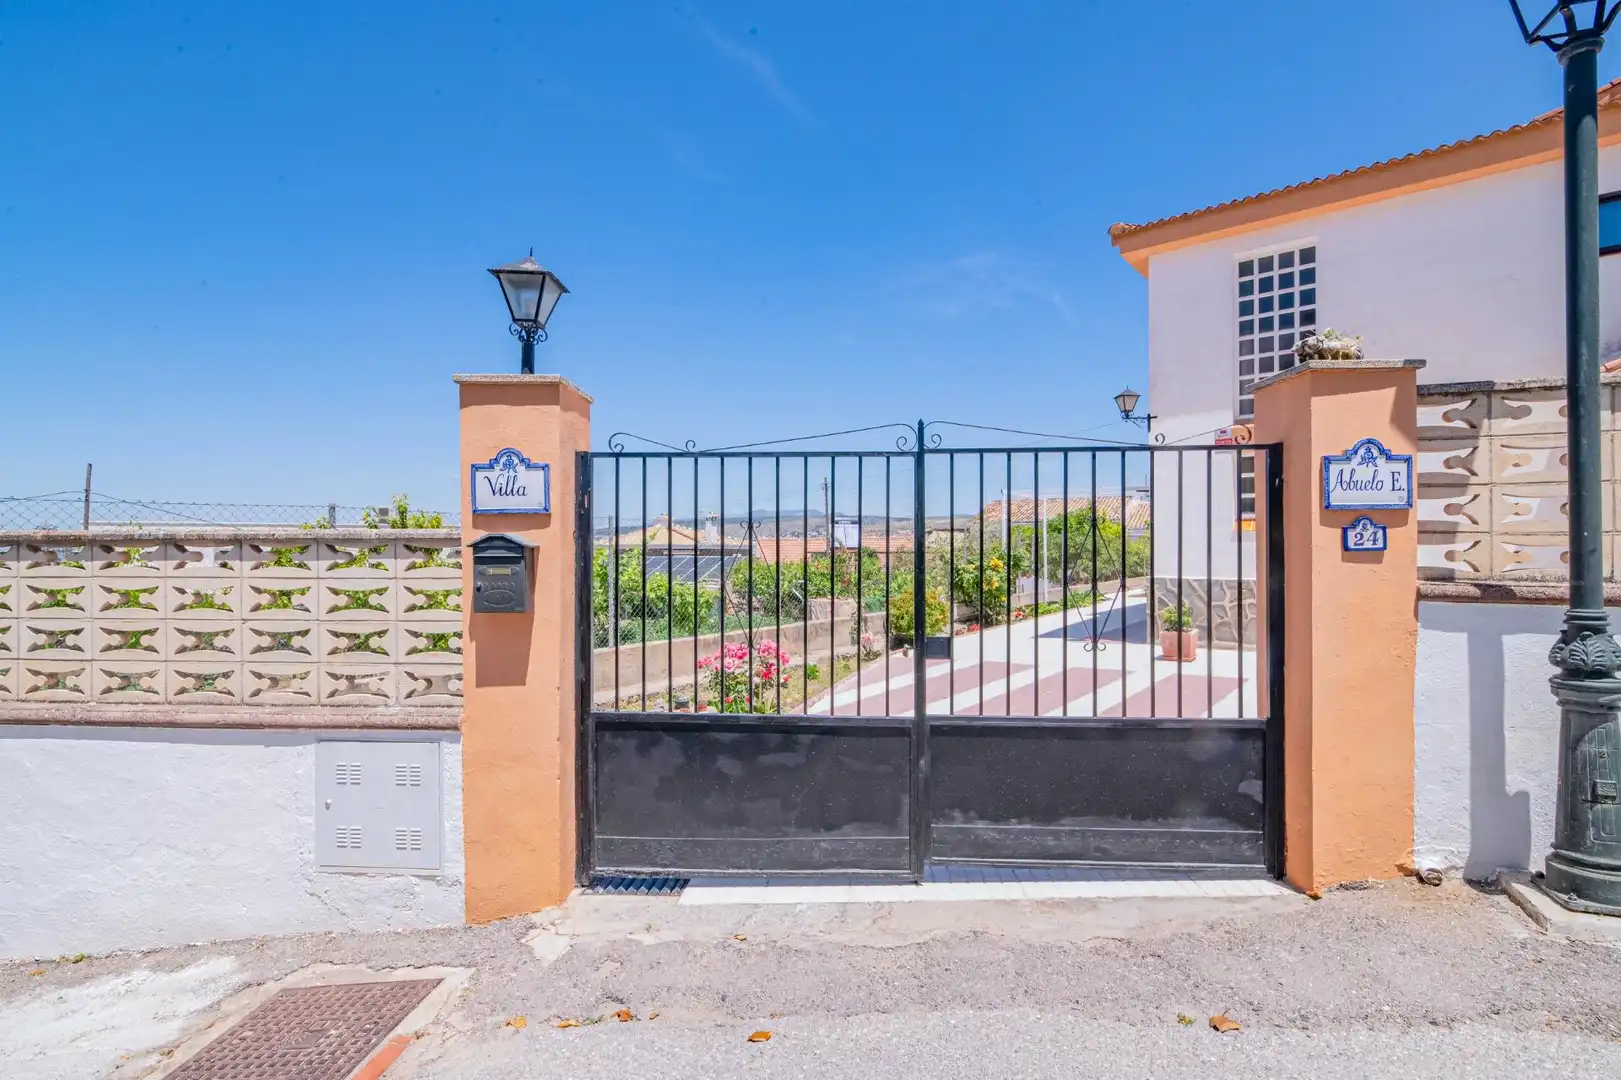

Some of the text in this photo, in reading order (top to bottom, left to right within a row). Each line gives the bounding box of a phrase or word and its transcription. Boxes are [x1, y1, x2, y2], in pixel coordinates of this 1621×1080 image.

[483, 474, 528, 497] Villa
[1330, 468, 1405, 492] Abuelo E.
[1353, 531, 1380, 547] 24
